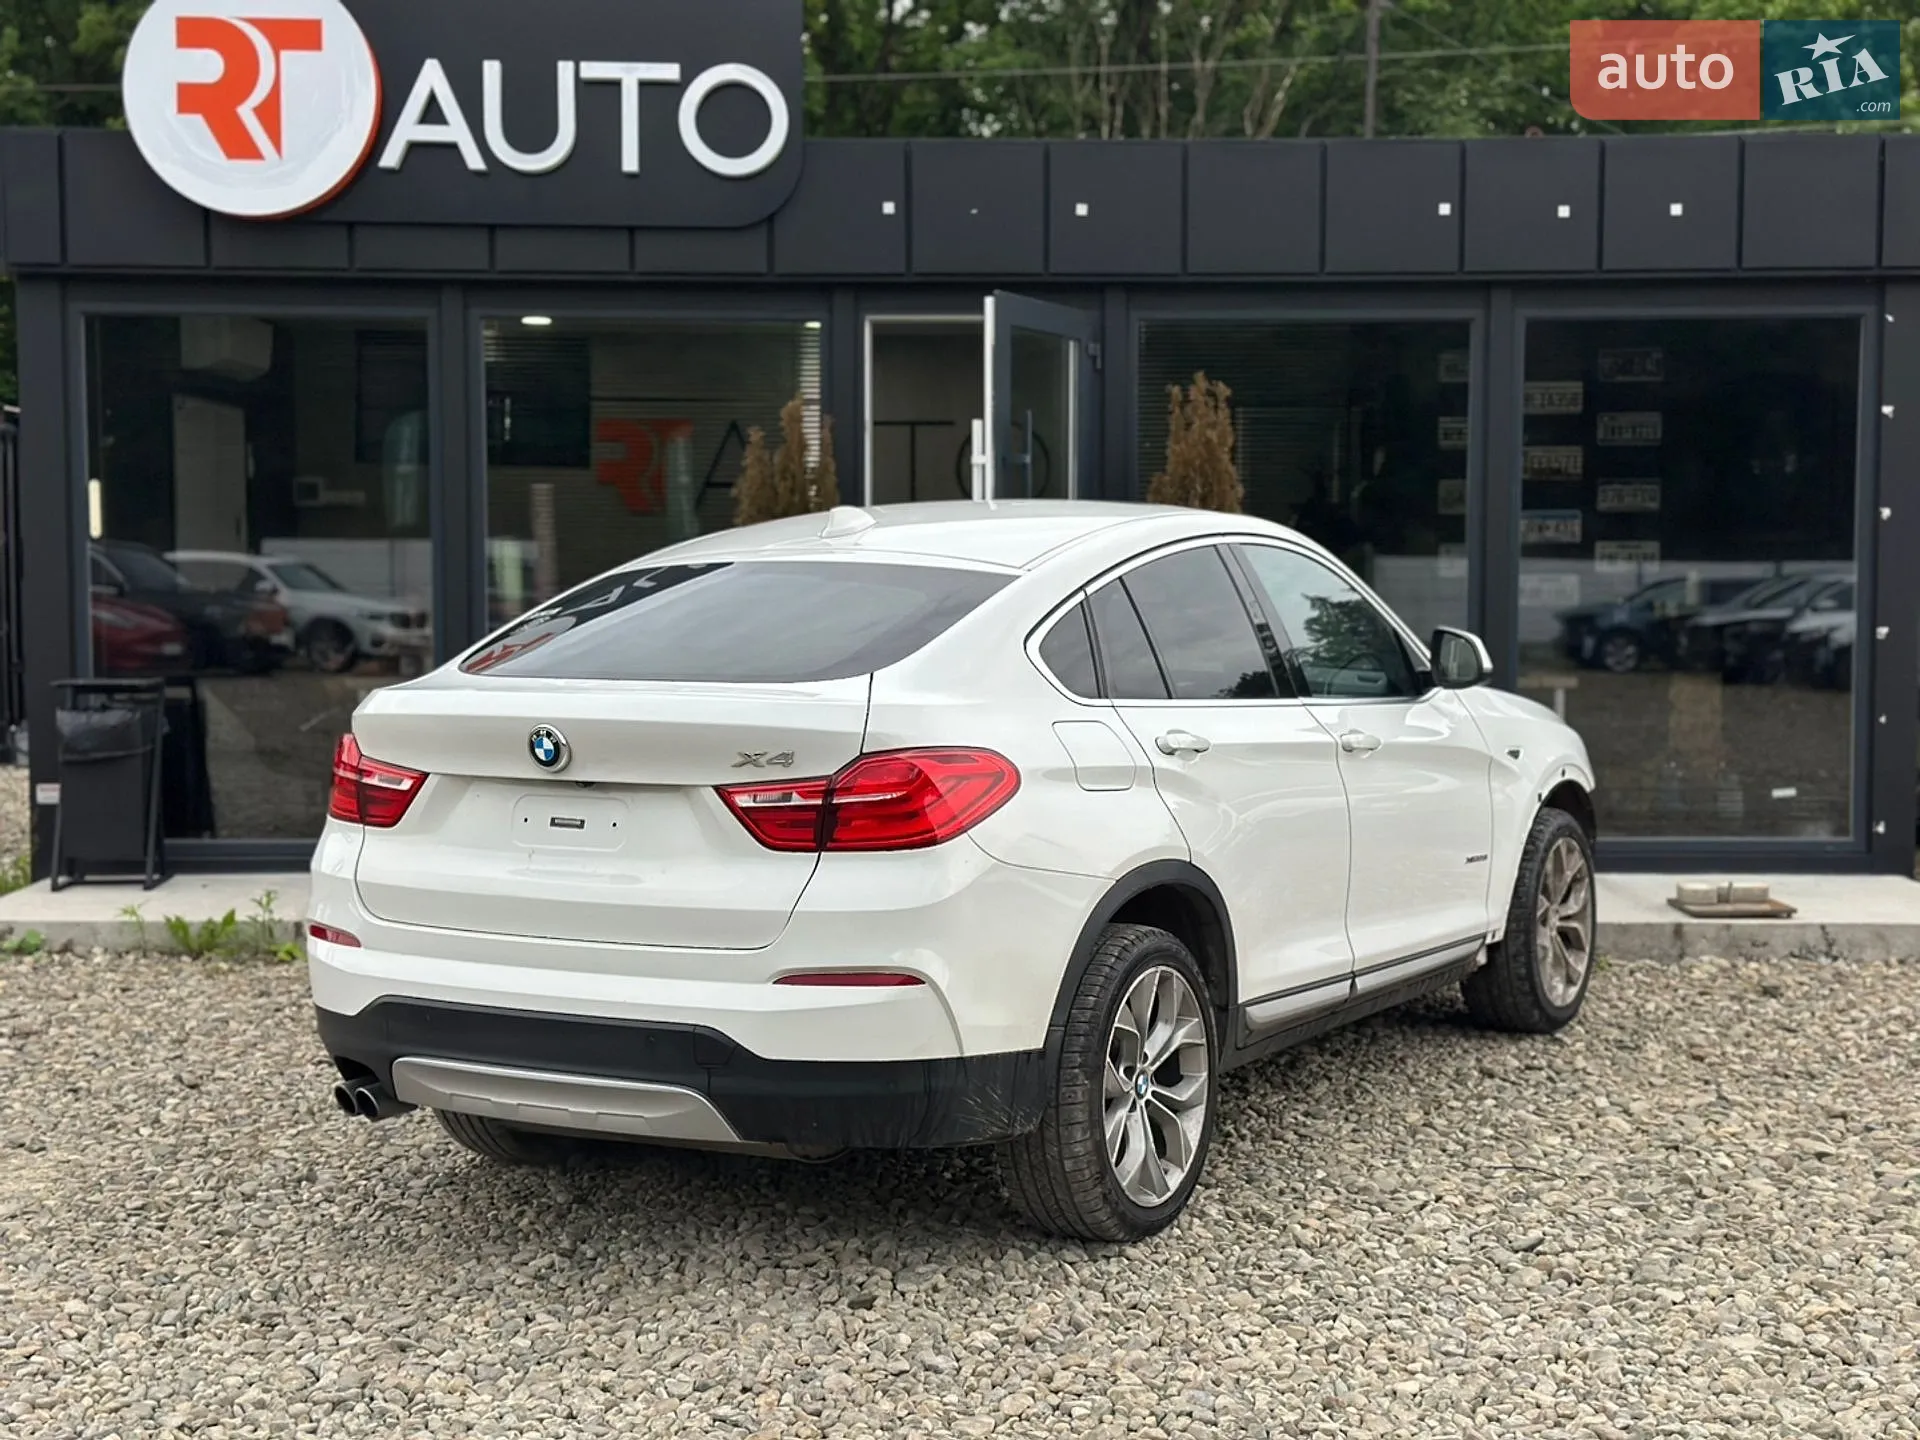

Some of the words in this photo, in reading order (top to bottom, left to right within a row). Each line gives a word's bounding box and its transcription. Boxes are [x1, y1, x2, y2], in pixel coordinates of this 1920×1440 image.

[176, 16, 322, 161] RT
[378, 58, 789, 177] AUTO
[731, 751, 795, 768] X4
